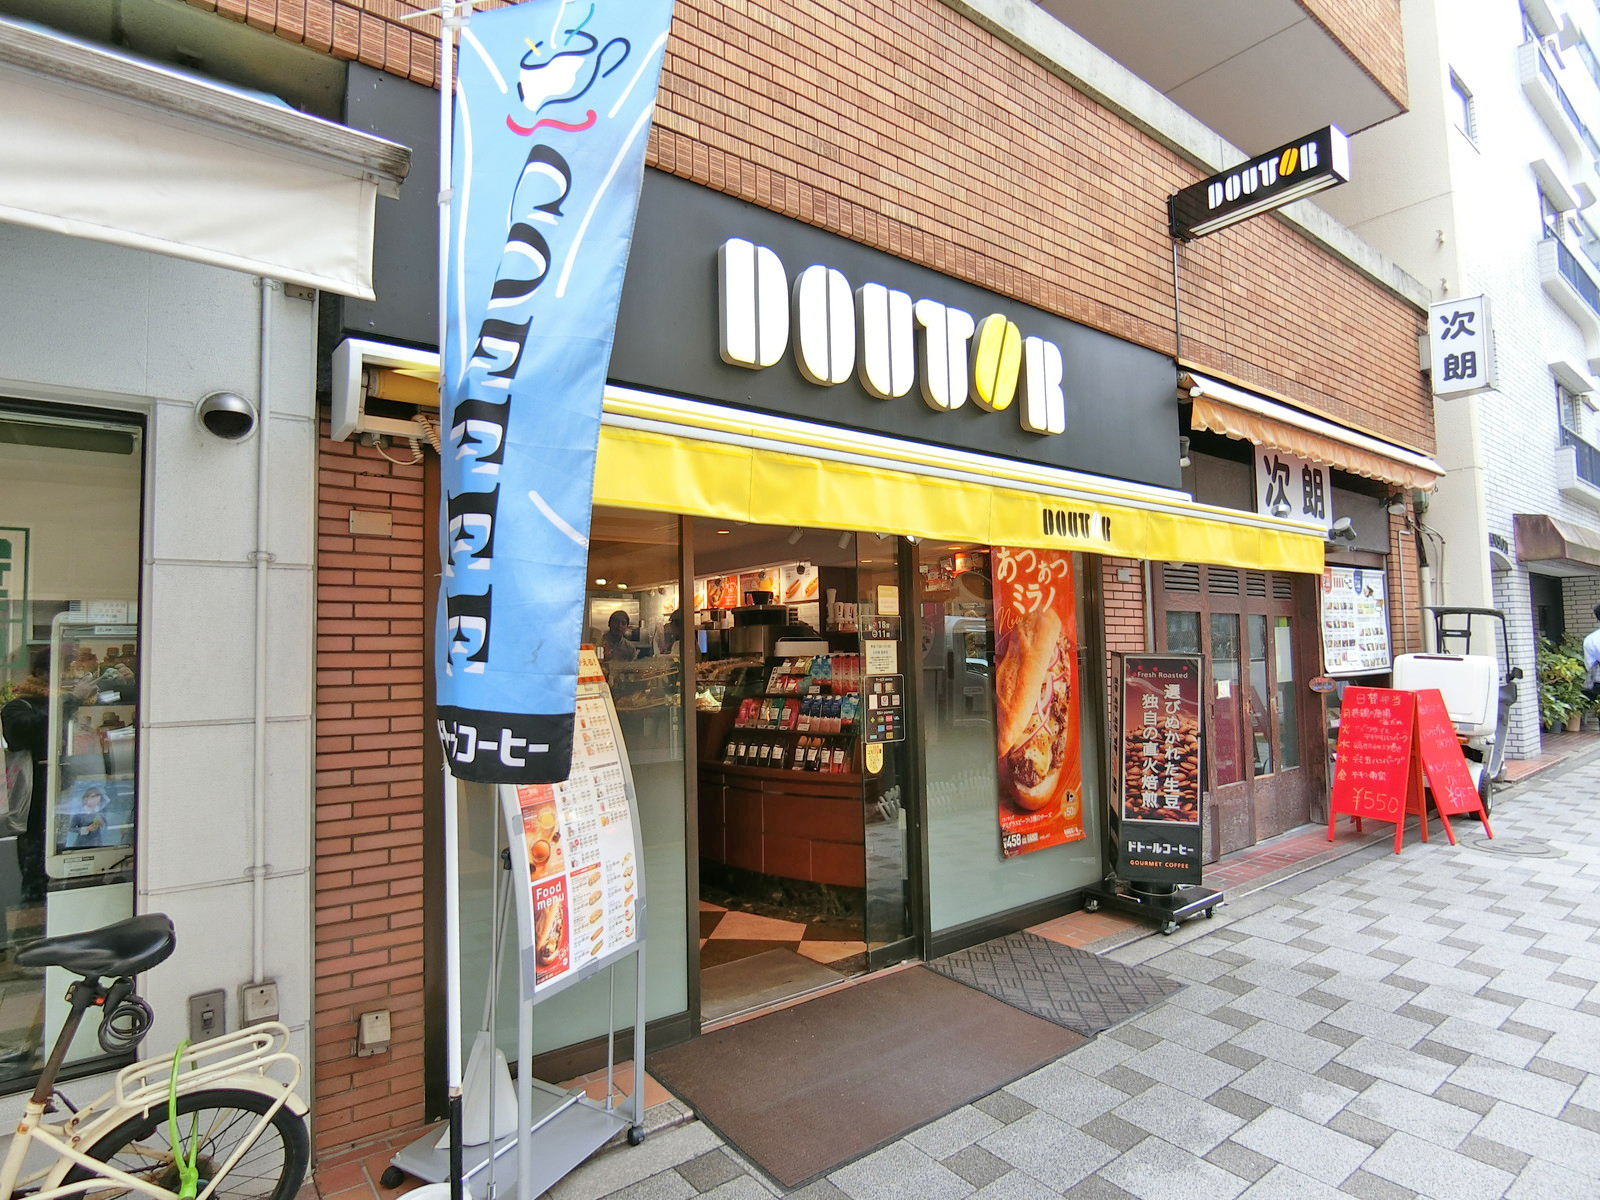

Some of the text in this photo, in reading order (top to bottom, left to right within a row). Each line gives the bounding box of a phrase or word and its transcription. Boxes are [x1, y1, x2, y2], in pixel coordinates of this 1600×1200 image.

[1207, 140, 1319, 210] DOUTOR
[719, 237, 1066, 435] DOUTOR
[1439, 310, 1477, 382] 次朗
[1263, 453, 1325, 520] 次朗
[1042, 508, 1111, 542] DOUTOR
[996, 546, 1068, 585] あつあつ
[1012, 583, 1056, 615] ミラノ
[996, 606, 1024, 635] New
[1137, 671, 1157, 679] Fresh
[1341, 723, 1350, 734] 火
[1141, 693, 1160, 809] 独自の直火焙煎
[1163, 683, 1181, 809] 選びぬかれた生豆
[1336, 768, 1347, 781] 金
[1352, 786, 1399, 813] ¥550
[1127, 840, 1194, 855] ドトールコーヒー
[1129, 859, 1162, 867] GOURMET
[535, 880, 562, 901] Food
[536, 892, 565, 911] menu
